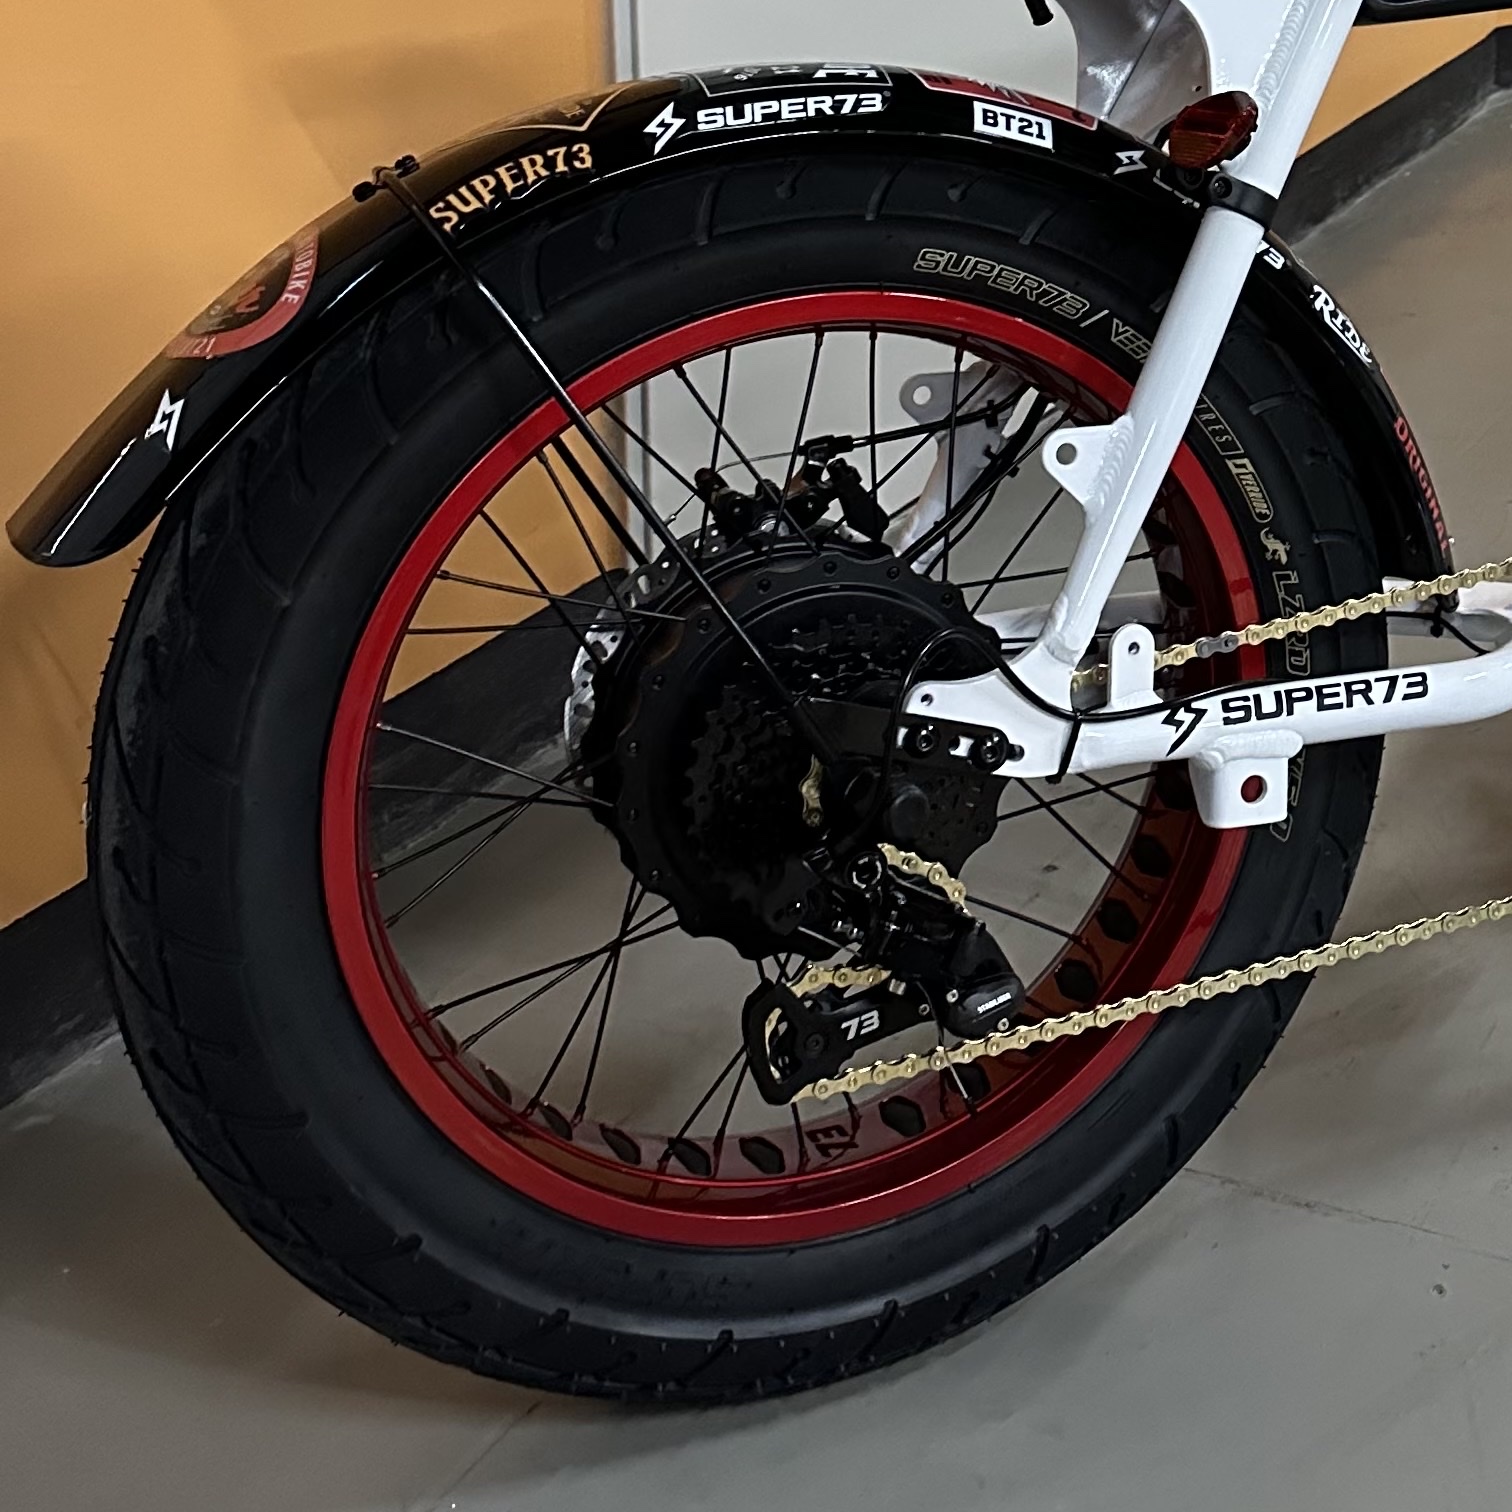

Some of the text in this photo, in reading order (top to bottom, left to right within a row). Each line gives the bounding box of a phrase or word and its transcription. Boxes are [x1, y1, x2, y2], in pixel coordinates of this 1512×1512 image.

[696, 92, 884, 131] SUPER73
[981, 107, 1047, 141] BT21
[428, 142, 594, 234] SUPER73
[913, 247, 1090, 320] SUPER73
[1312, 284, 1373, 365] RIDE
[1220, 671, 1430, 726] SUPER73
[840, 1009, 881, 1041] 73
